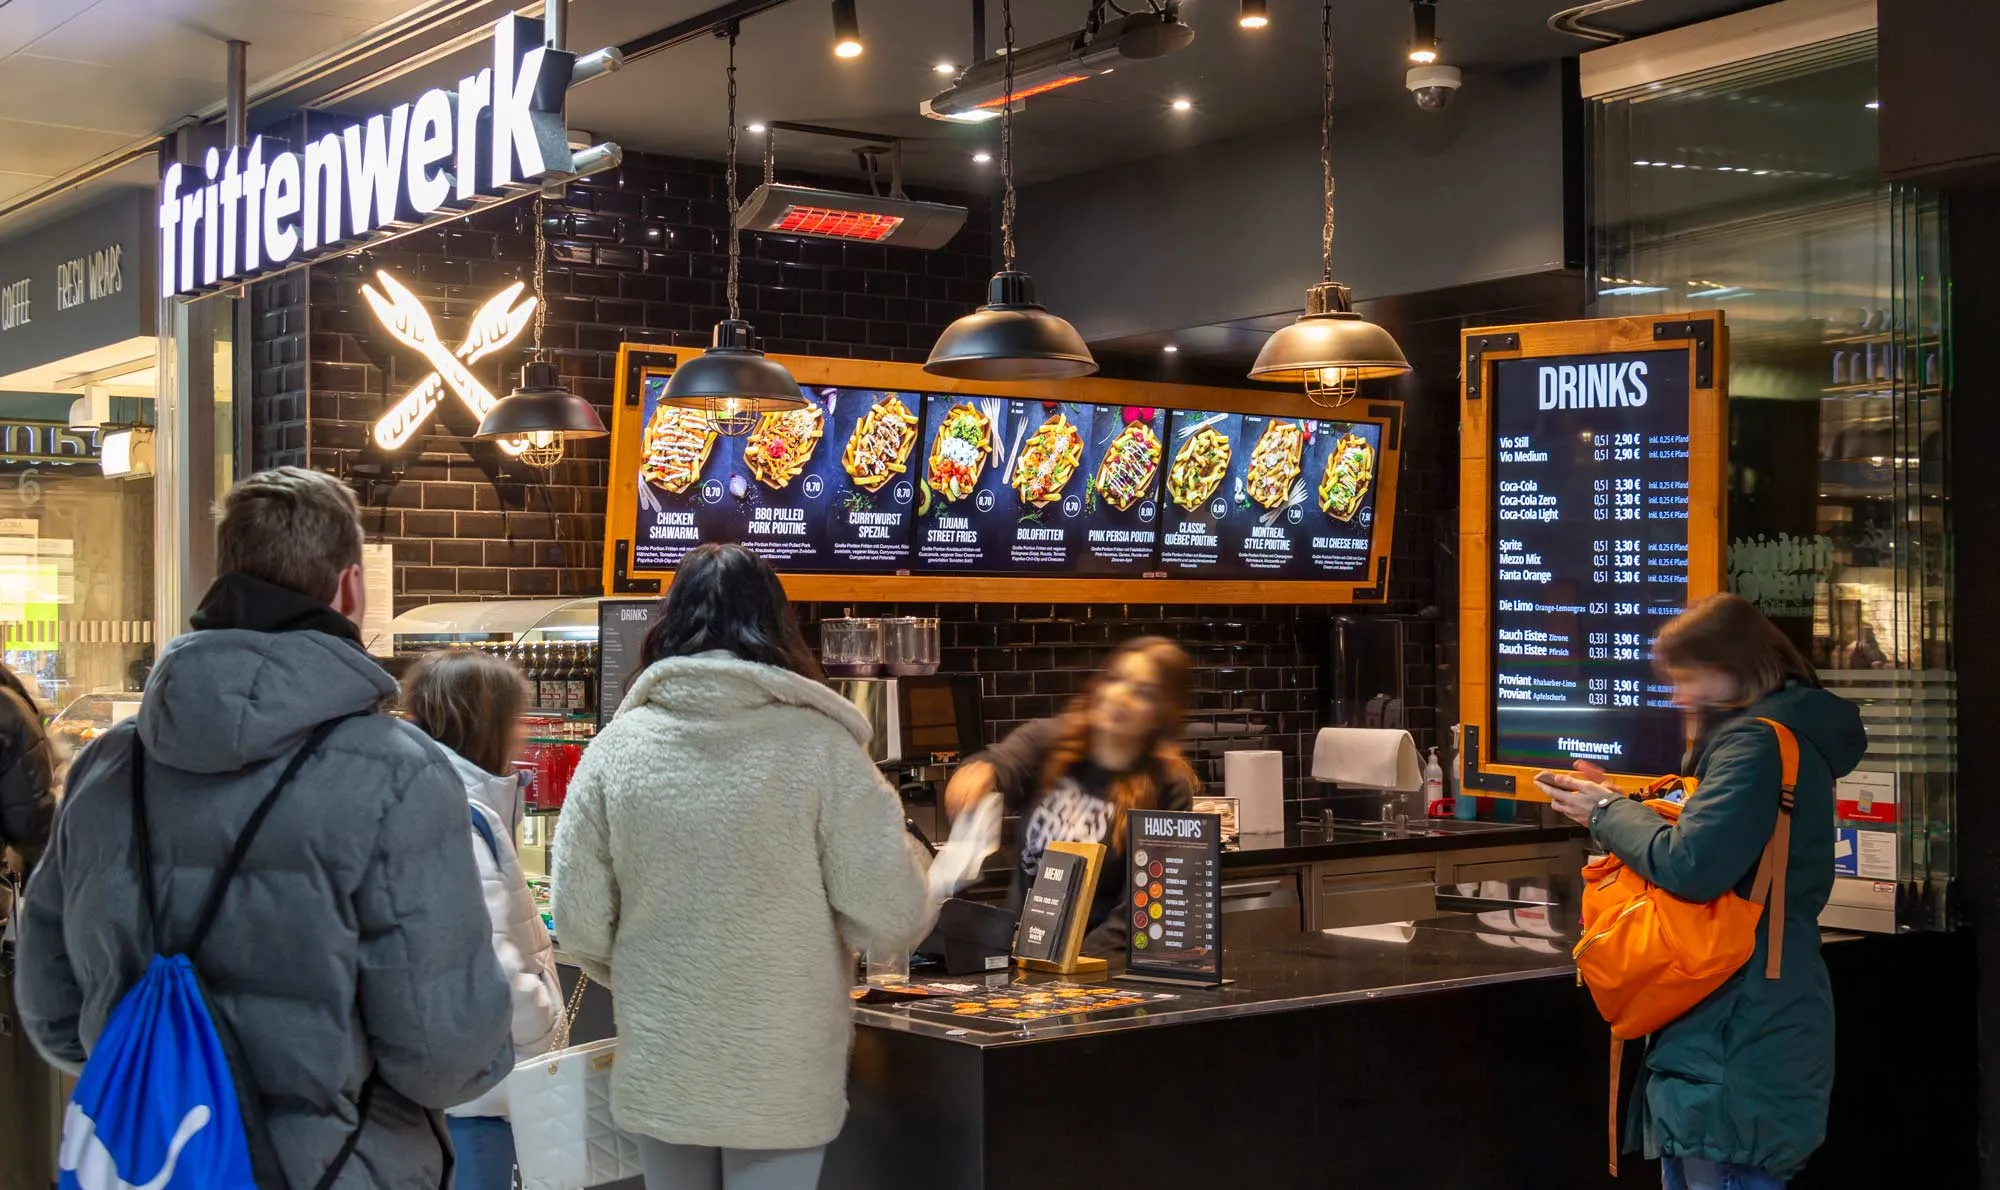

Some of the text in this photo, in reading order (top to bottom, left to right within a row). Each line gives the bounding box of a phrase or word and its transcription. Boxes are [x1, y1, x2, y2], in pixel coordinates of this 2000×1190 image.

[159, 10, 546, 298] frittenwerk
[57, 244, 122, 310] FRESH WRAPS
[2, 277, 32, 330] COFFEE
[1538, 361, 1648, 410] DRINKS
[1500, 437, 1513, 448] Vio
[1514, 436, 1529, 448] Still
[1614, 434, 1632, 446] 2,90
[1634, 434, 1641, 445] €
[1500, 451, 1513, 462] Vio
[1514, 450, 1547, 462] Medium
[1614, 448, 1632, 461] 2,90
[1634, 448, 1641, 460] €
[705, 487, 720, 497] 9,70
[806, 482, 820, 492] 9,70
[1500, 480, 1537, 492] Coca-Cola
[1614, 479, 1632, 492] 3,30
[1634, 479, 1641, 490] €
[896, 488, 910, 498] 8,70
[978, 496, 992, 506] 8,70
[1500, 494, 1537, 506] Coca-Cola
[1538, 495, 1556, 506] Zero
[1614, 494, 1632, 506] 3,30
[1634, 494, 1641, 504] €
[1066, 502, 1078, 512] 8,70
[657, 512, 694, 525] CHICKEN
[755, 508, 804, 520] BBQ PULLED
[850, 512, 902, 526] CURRYWURST
[1500, 508, 1537, 520] Coca-Cola
[1539, 509, 1558, 522] Light
[1614, 508, 1632, 521] 3,30
[1634, 508, 1641, 520] €
[748, 522, 806, 534] PORK POUTINE
[939, 517, 969, 530] TIJUANA
[1179, 522, 1206, 534] CLASSIC
[650, 526, 699, 540] SHAWARMA
[859, 526, 890, 538] SPEZIAL
[928, 530, 977, 542] STREET FRIES
[1017, 528, 1064, 541] BOLOFRITTEN
[1088, 530, 1105, 542] PINK
[1106, 531, 1129, 542] PERSIA
[1252, 527, 1285, 538] MONTREAL
[1164, 532, 1218, 546] QUÉBEC POUTINE
[1244, 538, 1291, 550] STYLE POUTINE
[1312, 537, 1368, 550] CHILI CHEESE FRIES
[1500, 539, 1522, 553] Sprite
[1614, 540, 1632, 552] 3,30
[1634, 540, 1640, 551] €
[1500, 554, 1524, 566] Mezzo
[1526, 554, 1541, 565] Mix
[1614, 555, 1632, 567] 3,30
[1634, 555, 1640, 566] €
[1500, 570, 1521, 581] Fanta
[1523, 570, 1551, 584] Orange
[1614, 571, 1632, 584] 3,30
[1634, 571, 1640, 582] €
[1500, 600, 1513, 611] Die
[1514, 600, 1533, 612] Limo
[1614, 604, 1632, 615] 3,50
[1633, 604, 1640, 614] €
[621, 609, 648, 621] DRINKS
[1500, 630, 1522, 641] Rauch
[1524, 630, 1547, 642] Eistee
[1614, 634, 1632, 645] 3,90
[1633, 634, 1640, 644] €
[1500, 644, 1522, 655] Rauch
[1524, 644, 1547, 656] Eistee
[1614, 648, 1632, 660] 3,90
[1633, 648, 1640, 659] €
[1499, 674, 1531, 686] Proviant
[1614, 680, 1632, 692] 3,90
[1633, 680, 1639, 692] €
[1499, 688, 1531, 700] Proviant
[1614, 694, 1632, 706] 3,90
[1633, 695, 1639, 706] €
[1558, 737, 1622, 754] frittenwerk
[1145, 817, 1201, 838] HAUS-DIPS
[1044, 866, 1064, 881] MENU
